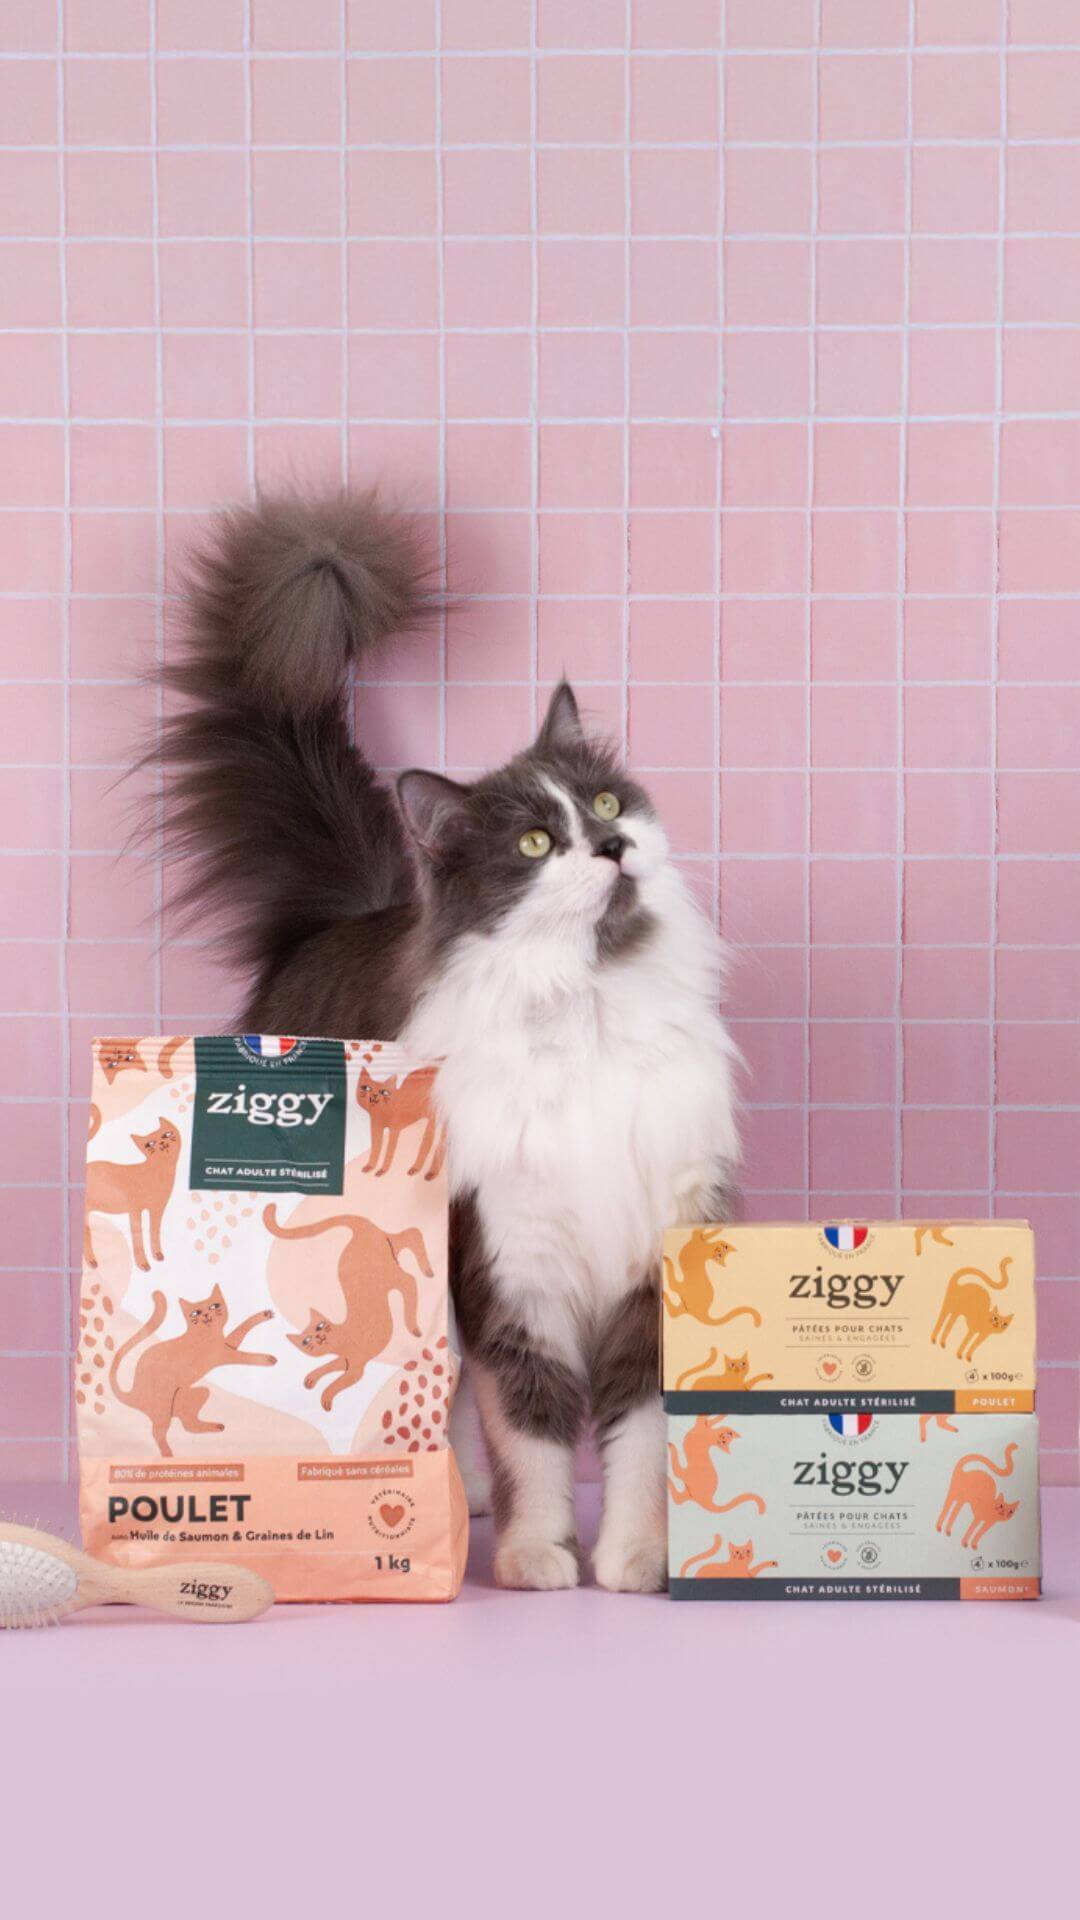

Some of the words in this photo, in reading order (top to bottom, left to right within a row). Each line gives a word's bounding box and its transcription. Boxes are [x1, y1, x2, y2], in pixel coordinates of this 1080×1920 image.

[206, 1084, 334, 1127] ziggy
[205, 1166, 233, 1175] CHAT
[236, 1167, 277, 1177] ADULTE
[279, 1167, 328, 1179] STÉRILISÉ
[788, 1266, 905, 1309] ziggy
[792, 1324, 831, 1333] PÂTÉES
[834, 1324, 865, 1333] POUR
[868, 1324, 904, 1333] CHATS
[780, 1398, 810, 1407] CHAT
[813, 1398, 856, 1407] ADULTE
[860, 1396, 916, 1407] STÉRILISÉ
[972, 1397, 1016, 1407] POULET
[114, 1469, 133, 1479] 80%
[134, 1469, 147, 1478] de
[148, 1468, 195, 1479] protéines
[196, 1467, 239, 1478] animales
[301, 1465, 344, 1478] Fabriqué
[345, 1466, 369, 1475] sans
[370, 1464, 409, 1475] céréales
[793, 1452, 910, 1496] ziggy
[108, 1495, 252, 1523] POULET
[796, 1511, 835, 1521] PÂTÉES
[839, 1512, 869, 1521] POUR
[873, 1512, 908, 1521] CHATS
[130, 1530, 160, 1541] Huile
[162, 1531, 176, 1542] de
[179, 1531, 229, 1542] Saumon
[232, 1531, 242, 1541] &
[245, 1530, 293, 1541] Graines
[297, 1529, 311, 1540] de
[315, 1529, 334, 1540] Lin
[374, 1556, 382, 1570] 1
[389, 1554, 411, 1573] kg
[180, 1580, 233, 1601] ziggy
[785, 1585, 814, 1594] CHAT
[819, 1585, 861, 1594] ADULTE
[866, 1583, 922, 1594] STÉRILISÉ
